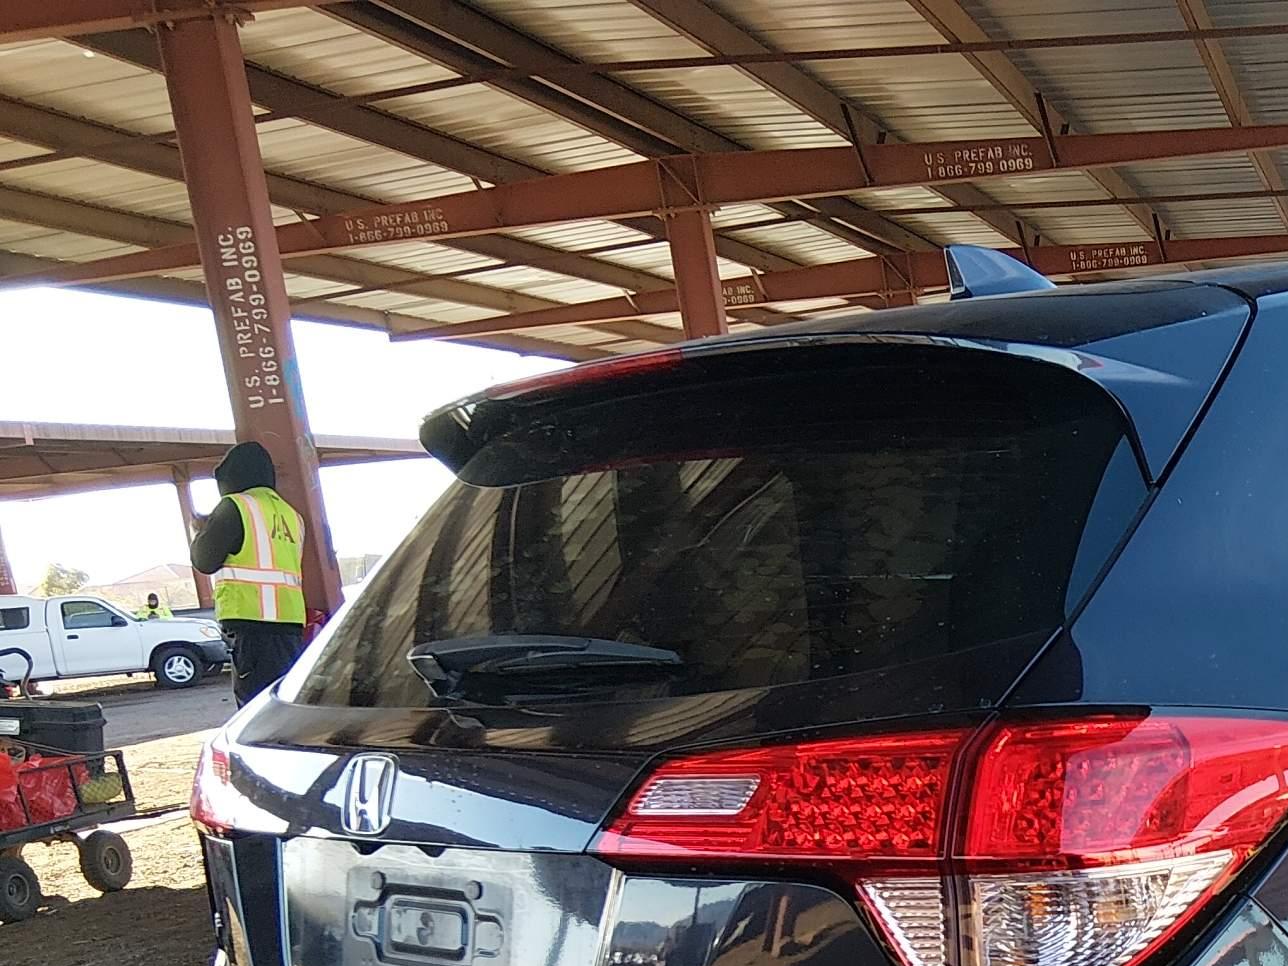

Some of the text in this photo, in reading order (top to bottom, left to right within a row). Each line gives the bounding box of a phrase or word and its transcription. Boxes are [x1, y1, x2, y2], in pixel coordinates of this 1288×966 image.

[954, 146, 1003, 162] PREFAB
[374, 211, 419, 228] PREFAB
[218, 226, 265, 409] U.S. PREFAB INC.
[236, 226, 285, 405] 1-866-799-0969
